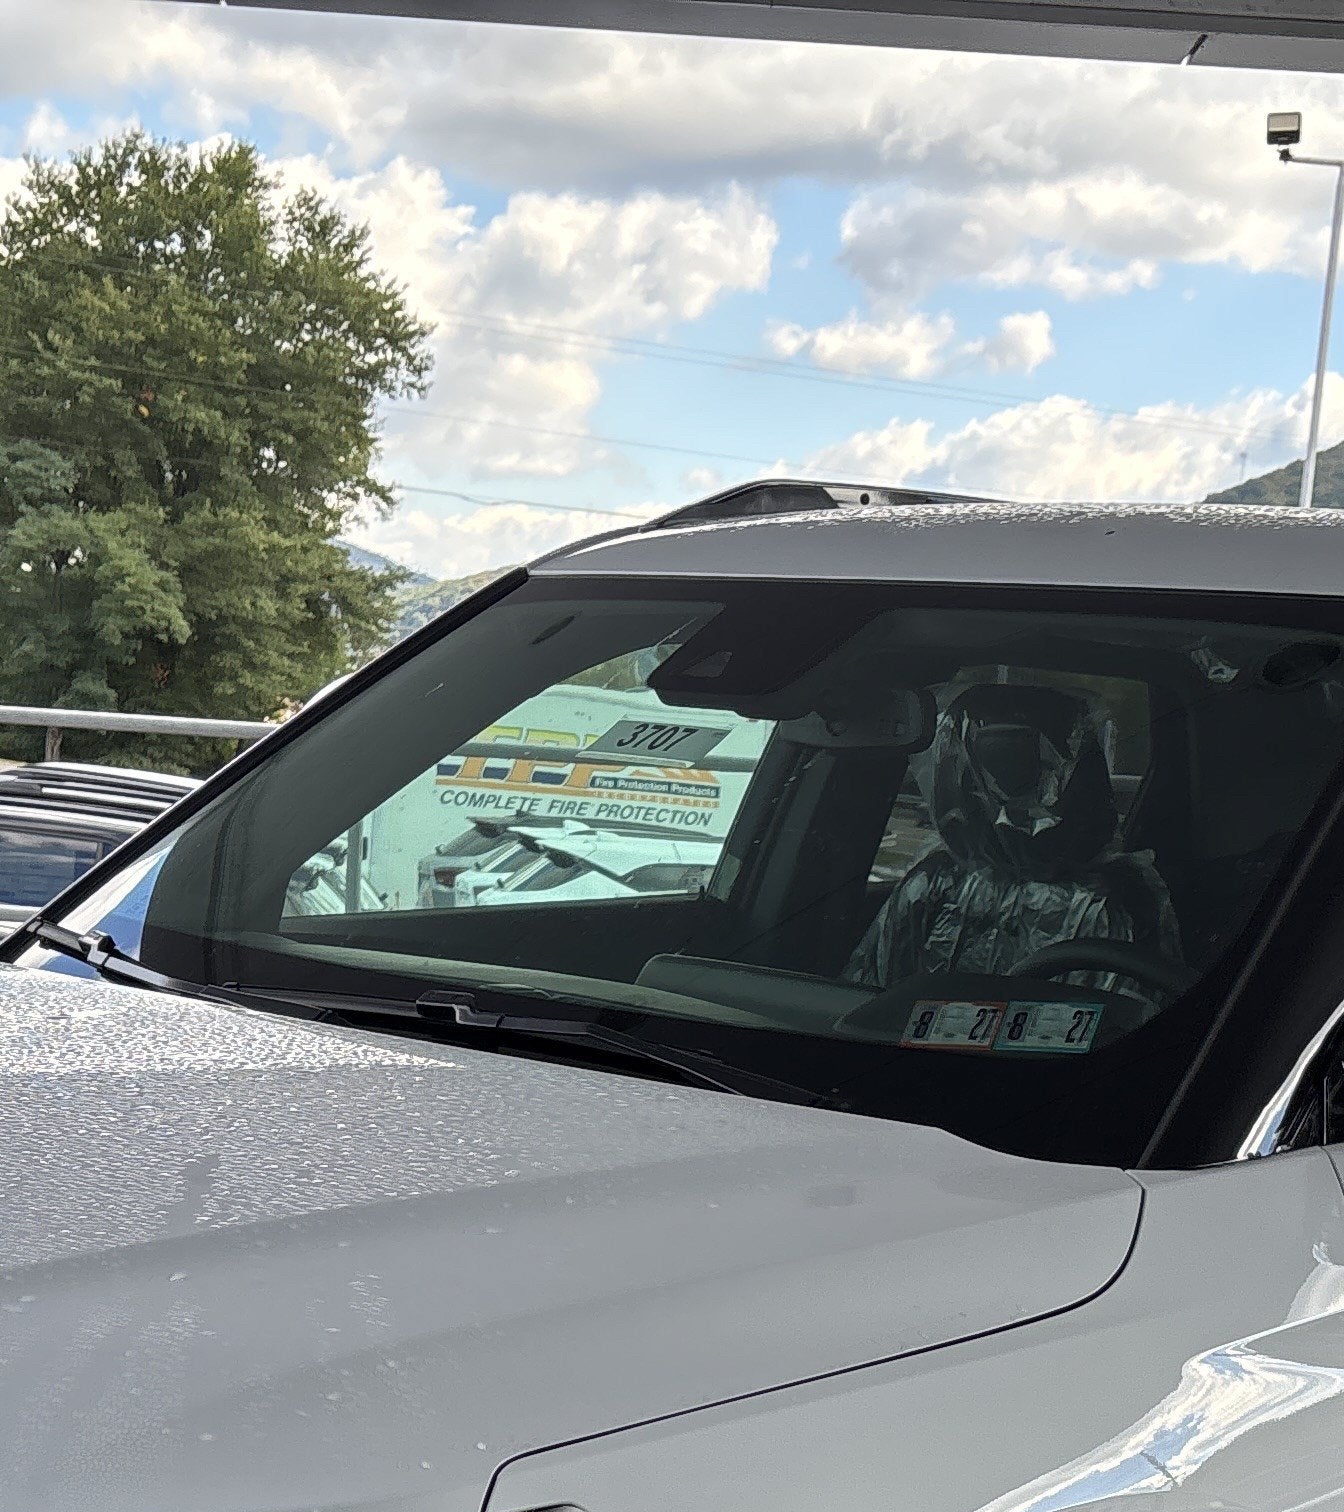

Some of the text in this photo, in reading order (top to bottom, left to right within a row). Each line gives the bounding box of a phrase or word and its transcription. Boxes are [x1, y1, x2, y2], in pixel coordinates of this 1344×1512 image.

[616, 723, 699, 752] 3707
[671, 782, 717, 798] Products
[439, 789, 539, 814] COMPLETE
[547, 799, 594, 817] FIRE
[596, 803, 714, 827] PROTECTION
[967, 1008, 999, 1041] 27
[1064, 1009, 1096, 1044] 27
